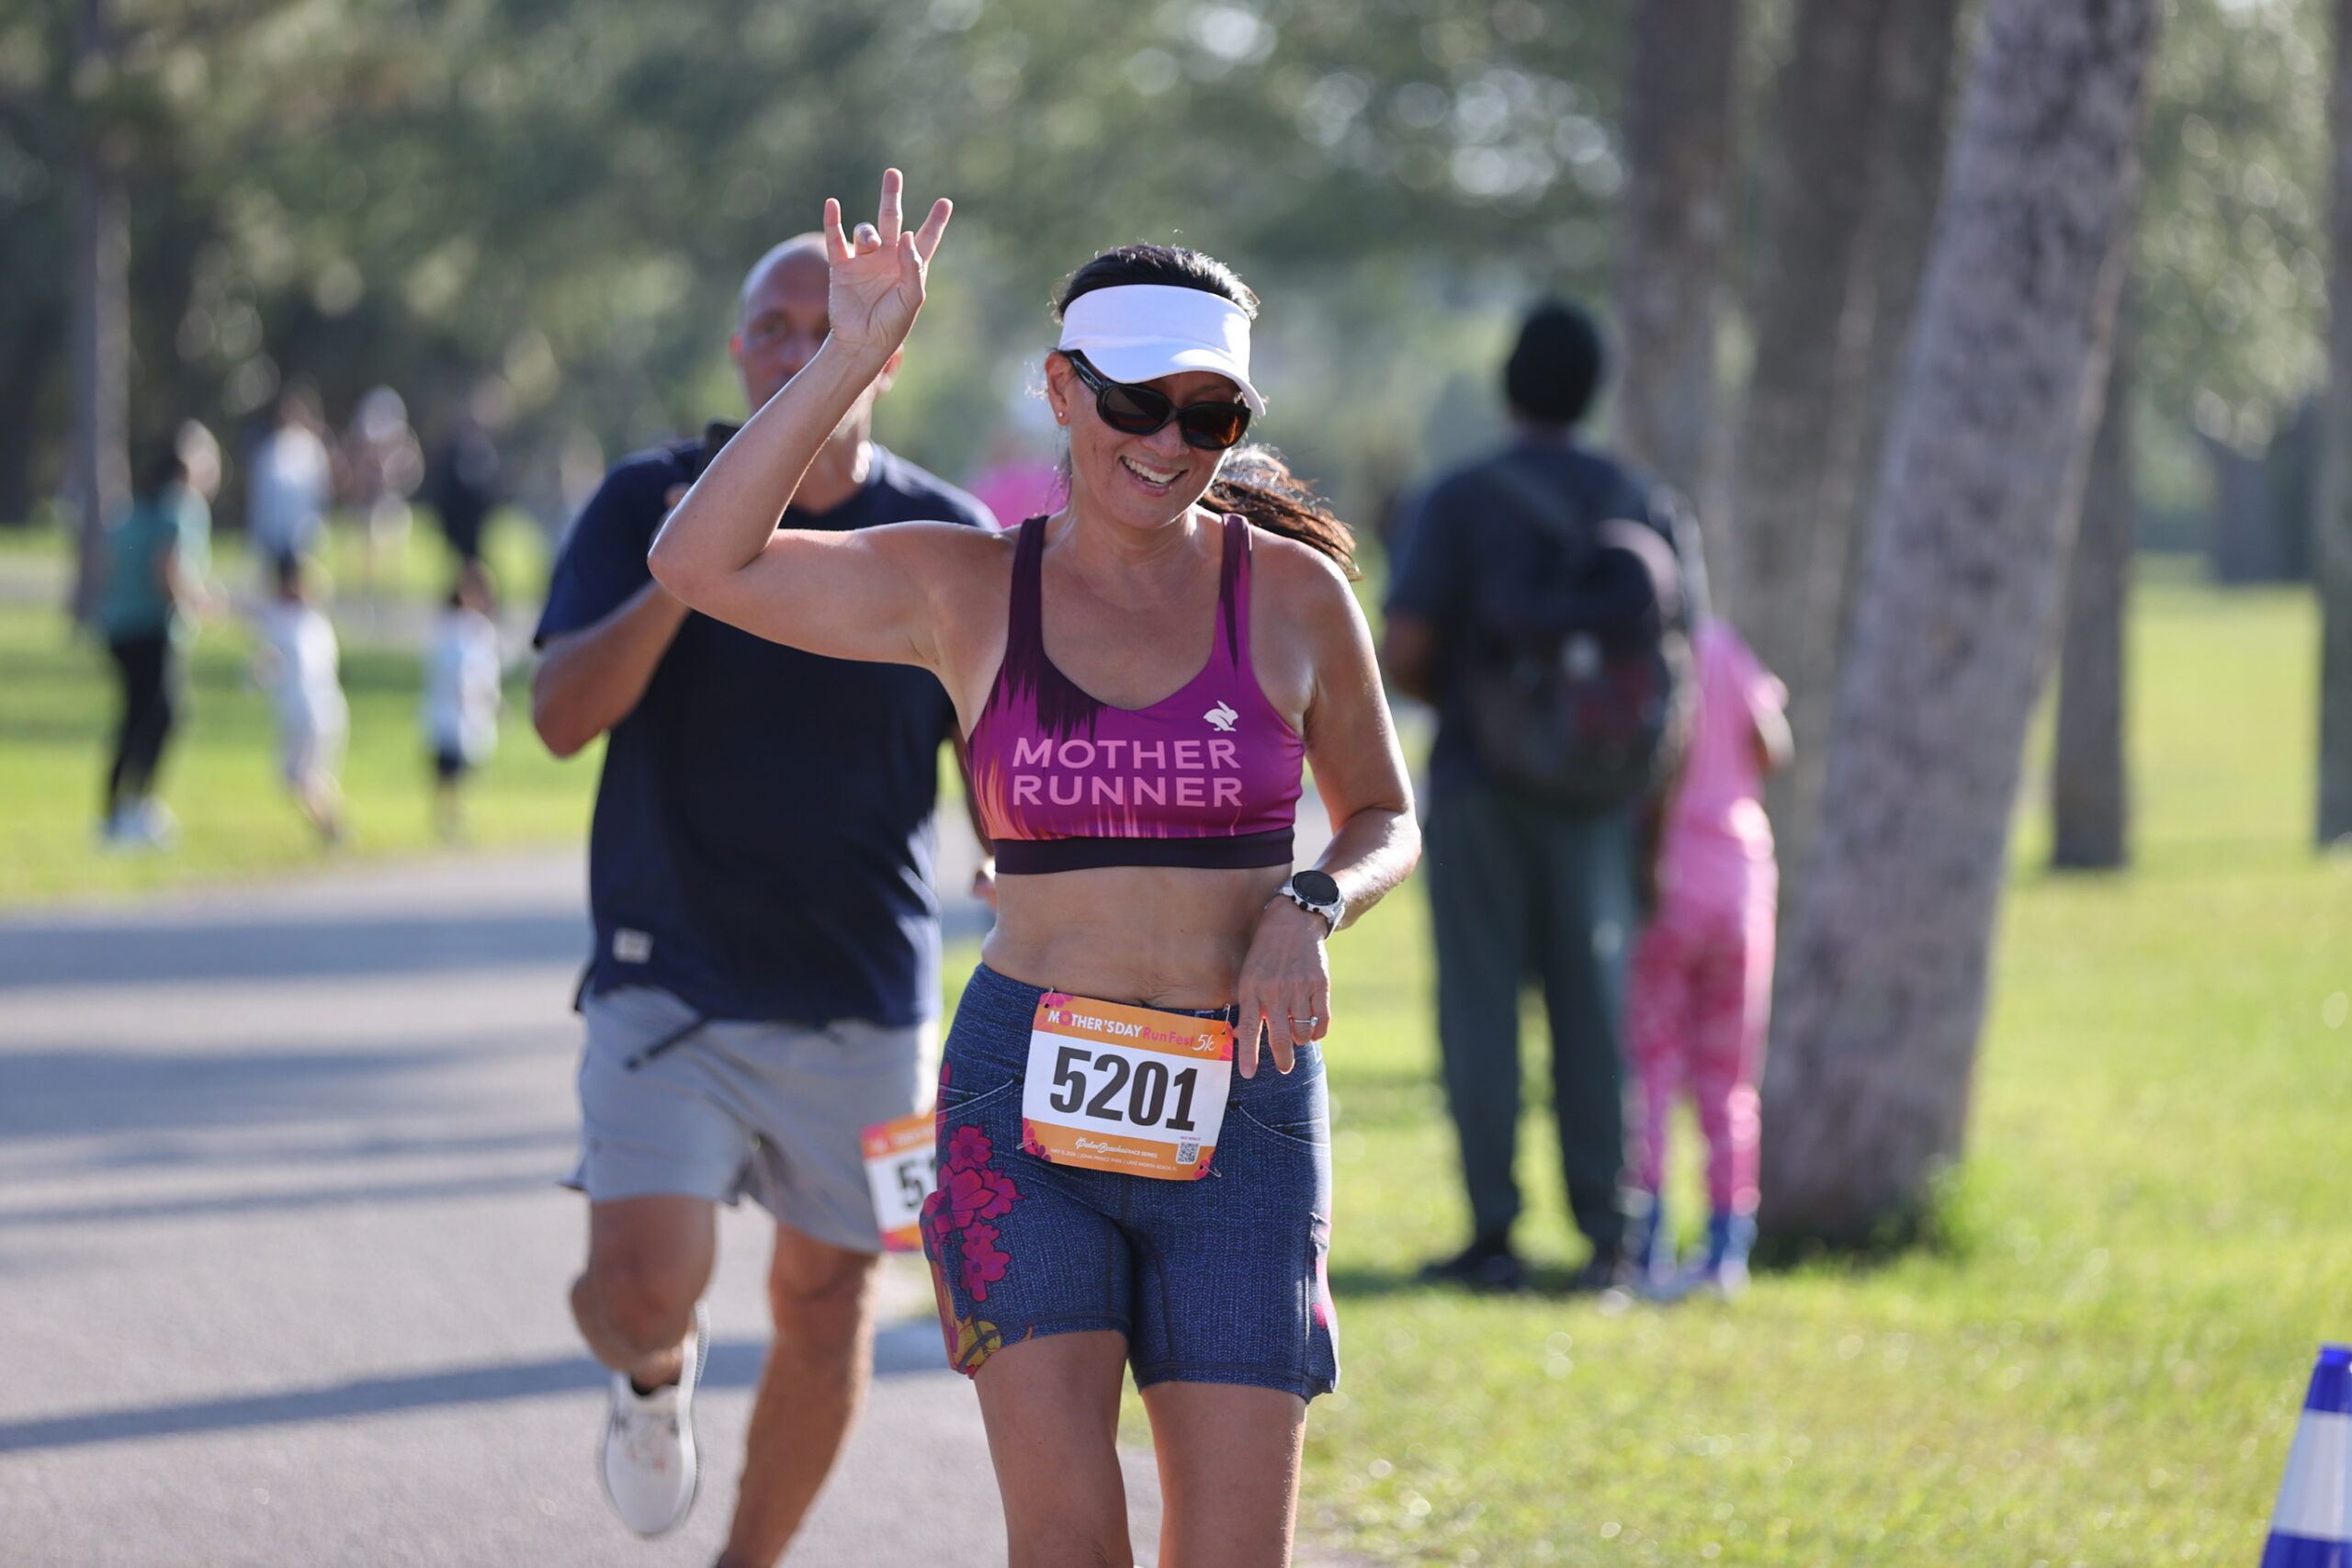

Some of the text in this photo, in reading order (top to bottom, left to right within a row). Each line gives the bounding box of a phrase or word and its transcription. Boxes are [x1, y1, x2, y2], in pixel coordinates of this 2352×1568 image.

[1012, 738, 1241, 770] MOTHER
[1012, 775, 1243, 807] RUNNER
[1049, 1045, 1198, 1132] 5201
